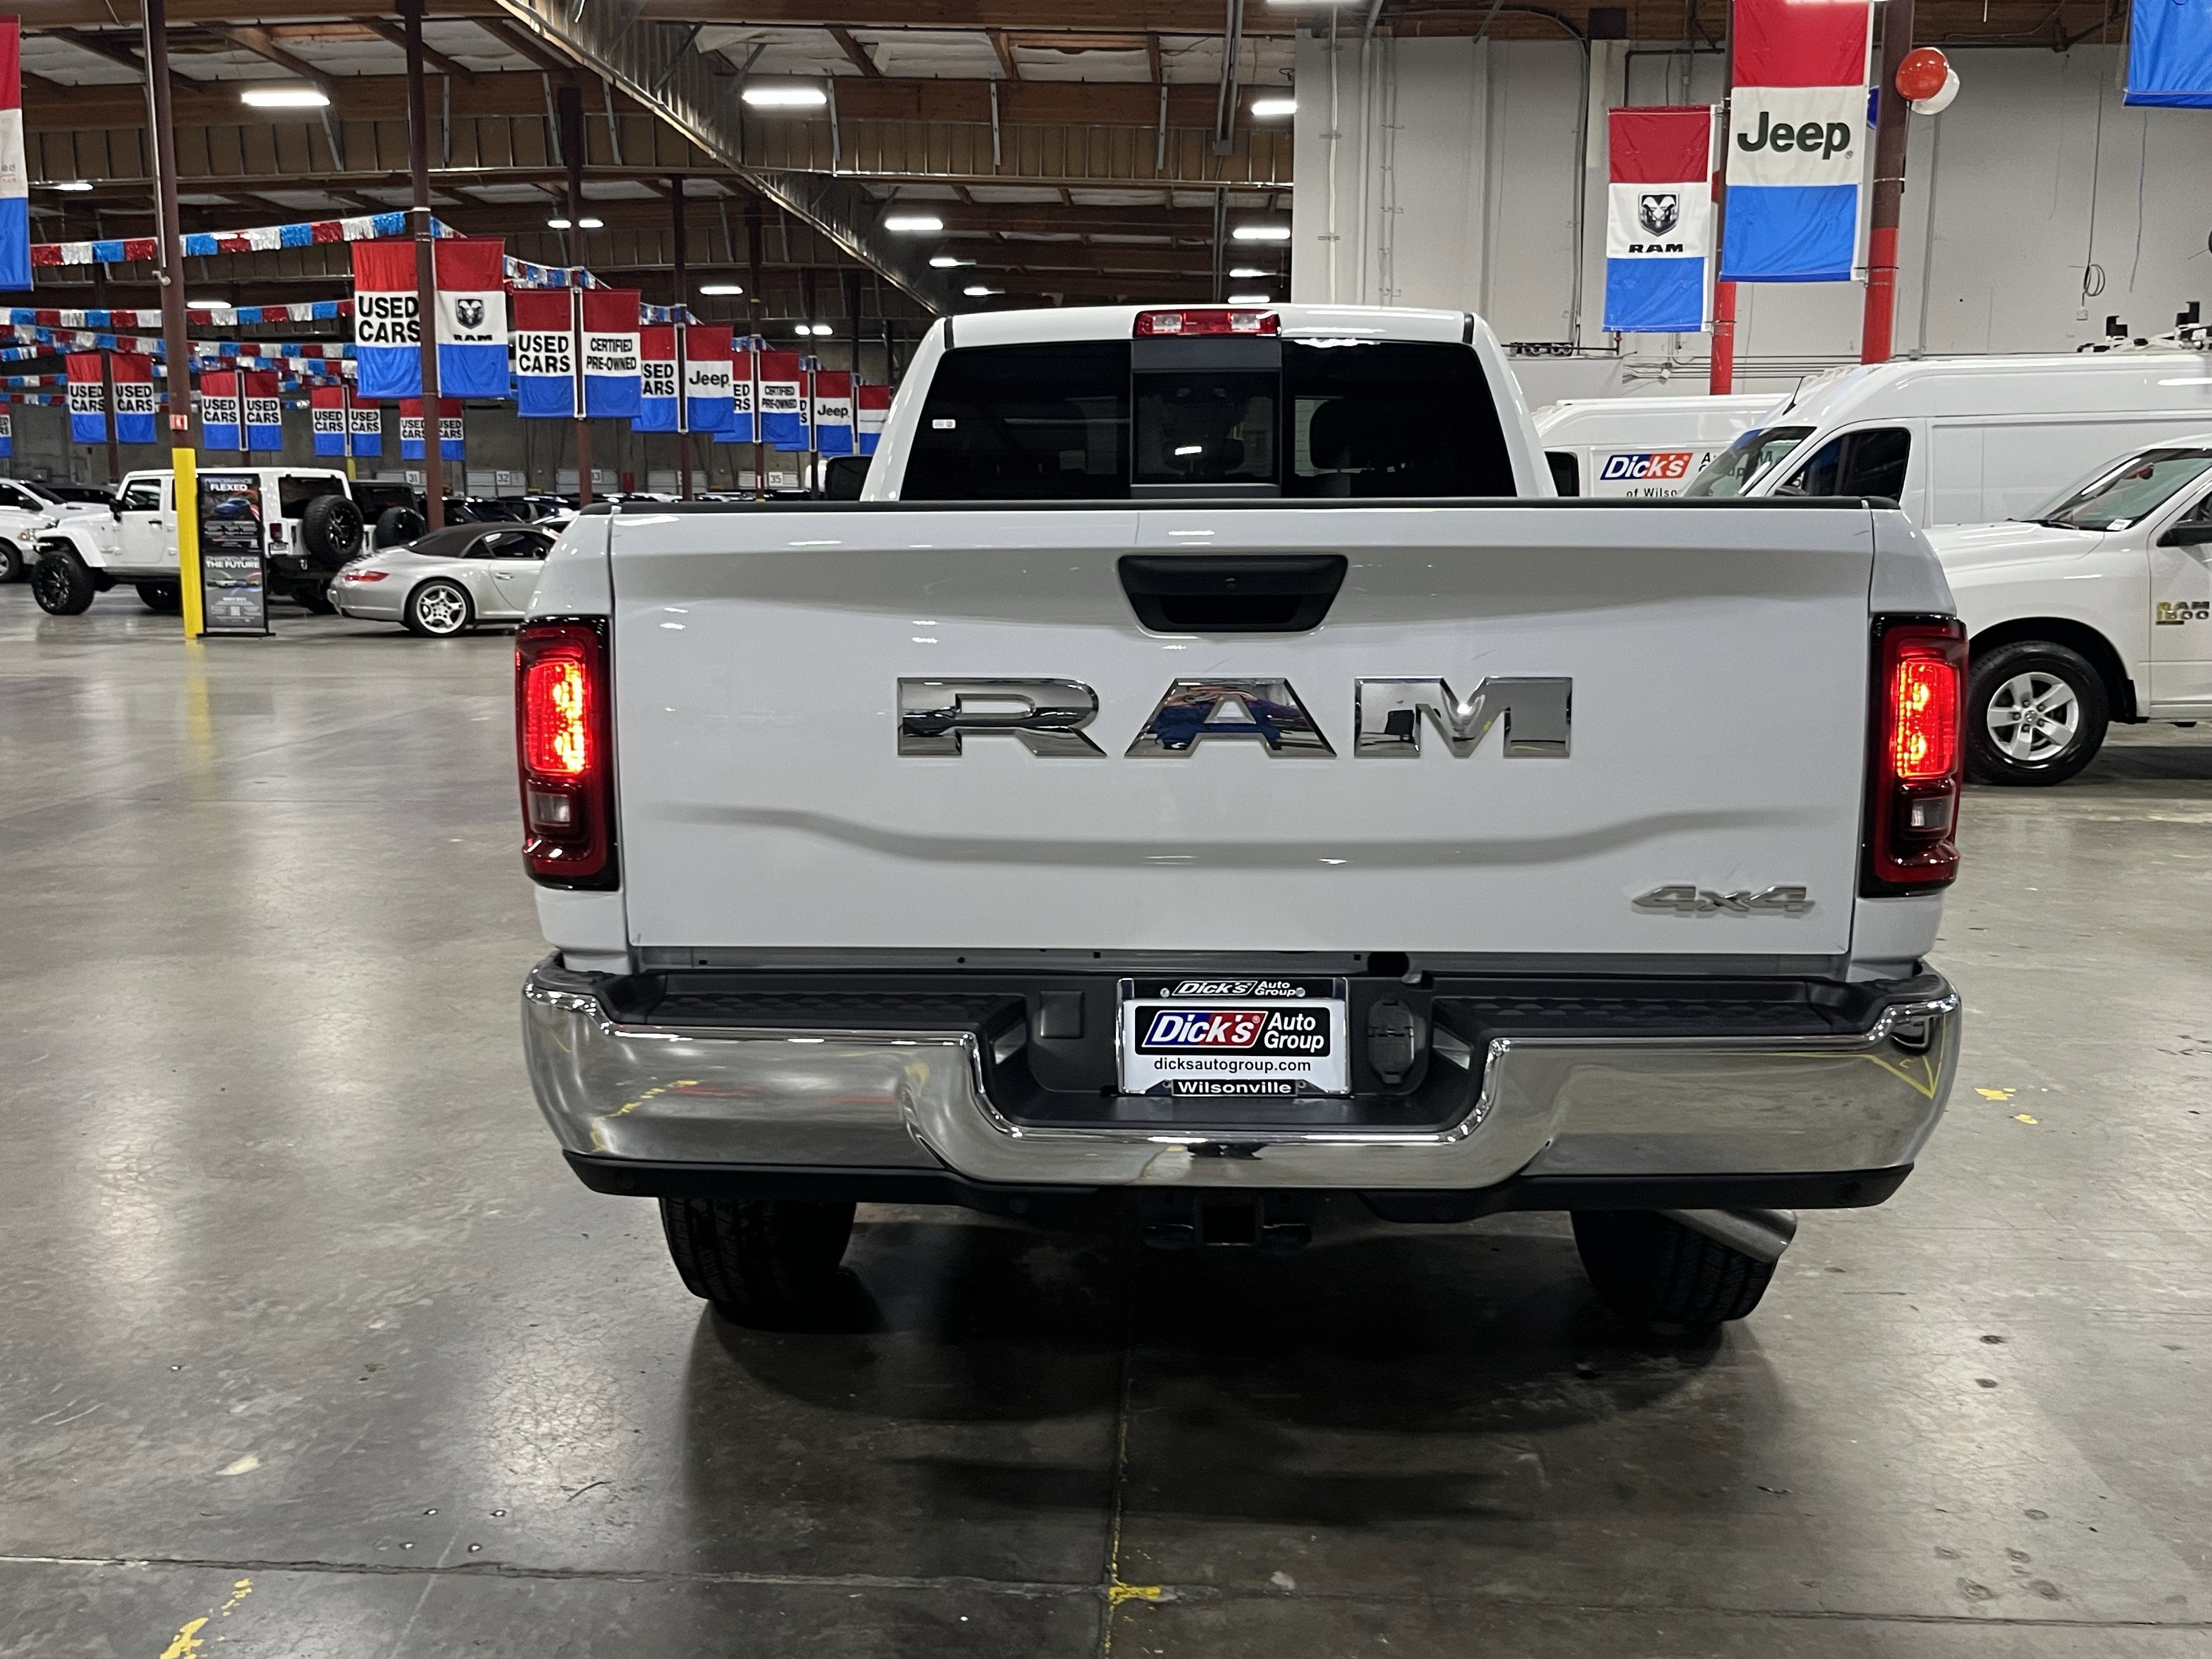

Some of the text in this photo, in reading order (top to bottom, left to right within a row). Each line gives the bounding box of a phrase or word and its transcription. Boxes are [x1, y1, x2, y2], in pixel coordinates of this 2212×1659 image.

[1736, 111, 1851, 160] Jeep
[1628, 243, 1684, 253] RAM
[358, 296, 419, 319] USED
[359, 320, 420, 343] CARS
[518, 334, 569, 353] USED
[590, 337, 633, 352] CERTIFIED
[519, 354, 571, 373] CARS
[586, 356, 636, 371] PRE-OWNED
[642, 363, 674, 379] SED
[689, 370, 730, 388] Jeep
[70, 385, 104, 398] USED
[116, 385, 152, 398] USED
[643, 380, 675, 395] ARS
[71, 399, 105, 411] CARS
[117, 399, 153, 411] CARS
[204, 398, 236, 410] USED
[247, 399, 278, 411] USED
[204, 411, 237, 422] CARS
[247, 412, 279, 424] CARS
[314, 411, 343, 421] USED
[351, 410, 379, 421] USED
[817, 405, 849, 418] Jeep
[315, 422, 343, 431] CARS
[351, 422, 379, 432] CARS
[402, 419, 425, 428] USED
[402, 430, 425, 438] CARS
[1605, 455, 1684, 478] Dick's
[498, 473, 509, 482] 32
[770, 475, 782, 483] 35
[2156, 601, 2210, 610] RAM
[897, 676, 1573, 759] RAM
[1632, 884, 1816, 914] 4x4
[1177, 981, 1290, 995] Dick's Auto
[1255, 988, 1296, 997] Group
[1152, 1013, 1316, 1043] Dick's Auto
[1264, 1031, 1324, 1053] Group
[1154, 1058, 1311, 1073] dicksautogroup.com
[1177, 1081, 1293, 1094] Wilsonville
